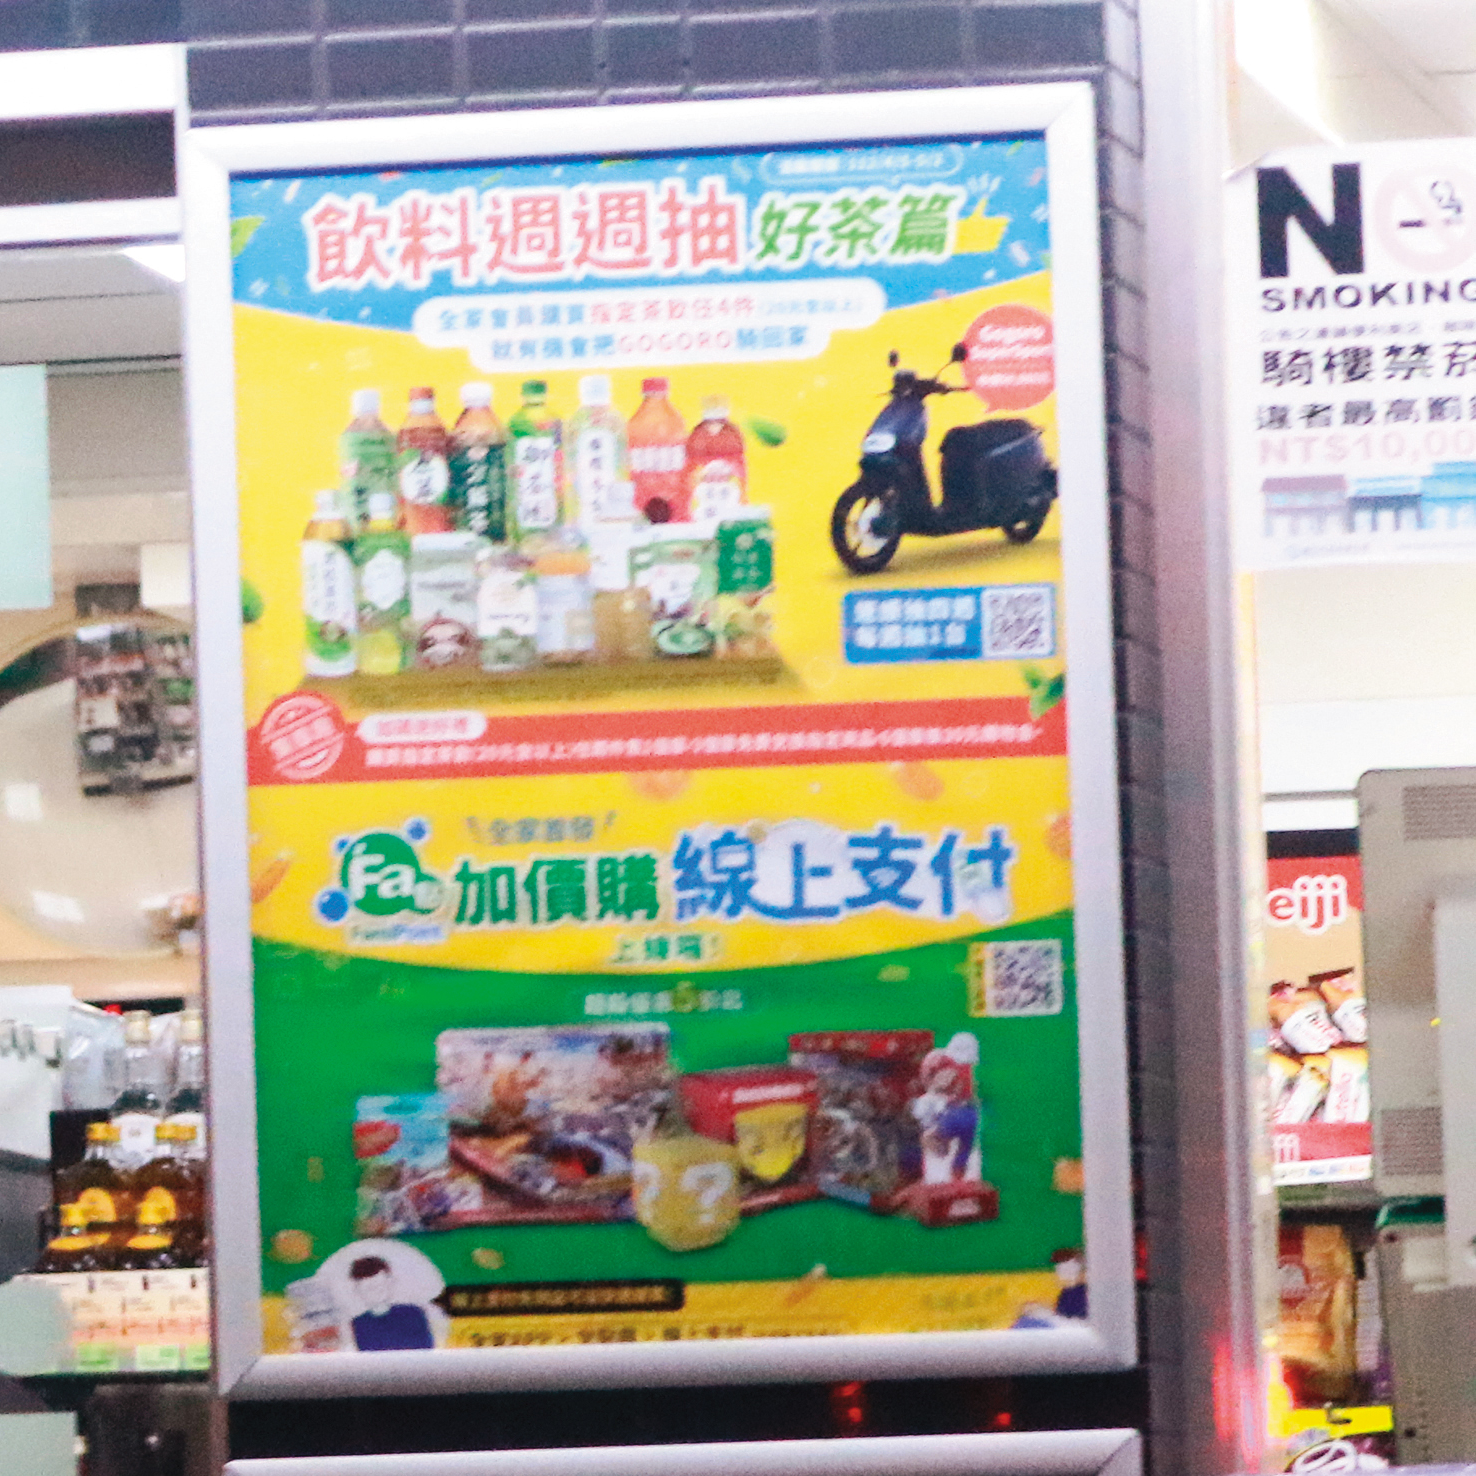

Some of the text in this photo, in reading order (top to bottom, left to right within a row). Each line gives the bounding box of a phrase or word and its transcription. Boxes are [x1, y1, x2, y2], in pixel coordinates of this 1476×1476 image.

[312, 184, 959, 284] 飲料週週抽 好茶篇
[455, 825, 1015, 925] 加價購 線上支付
[1268, 875, 1348, 935] eiji
